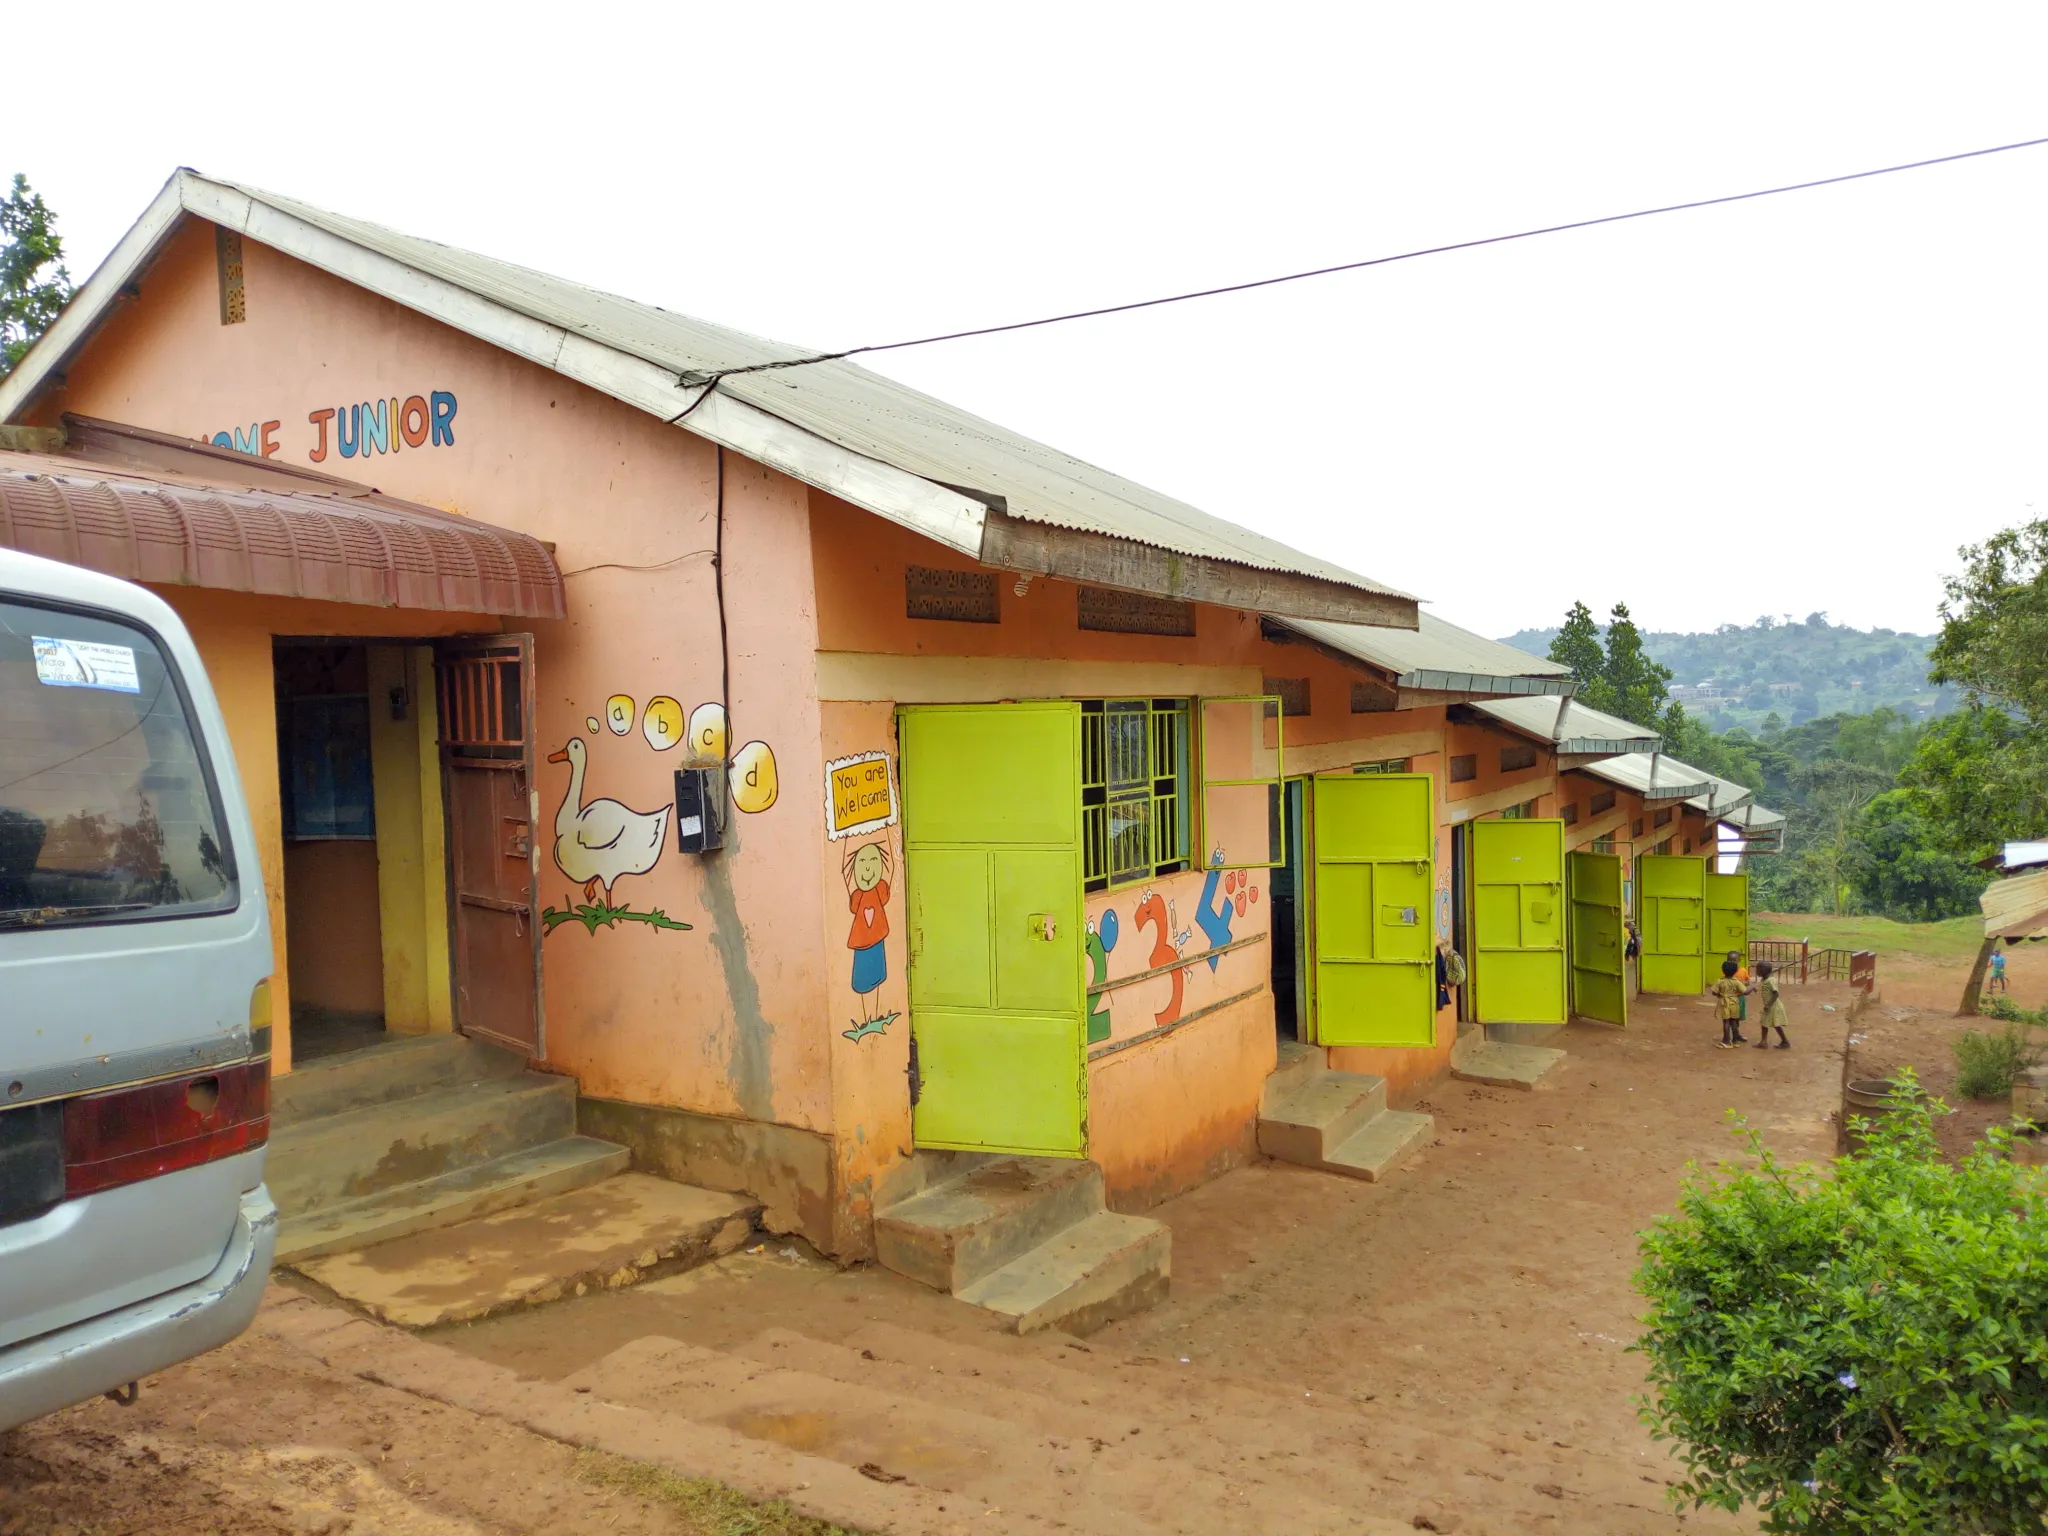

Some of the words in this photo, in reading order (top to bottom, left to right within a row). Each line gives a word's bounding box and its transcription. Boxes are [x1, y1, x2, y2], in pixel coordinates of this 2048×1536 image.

[309, 390, 457, 463] JUNIOR
[613, 706, 624, 721] a
[658, 714, 669, 734] b
[702, 728, 713, 746] c
[745, 762, 758, 787] d
[837, 773, 858, 791] You
[865, 766, 884, 782] are
[837, 788, 888, 820] Welcome
[1134, 891, 1183, 1039] 3
